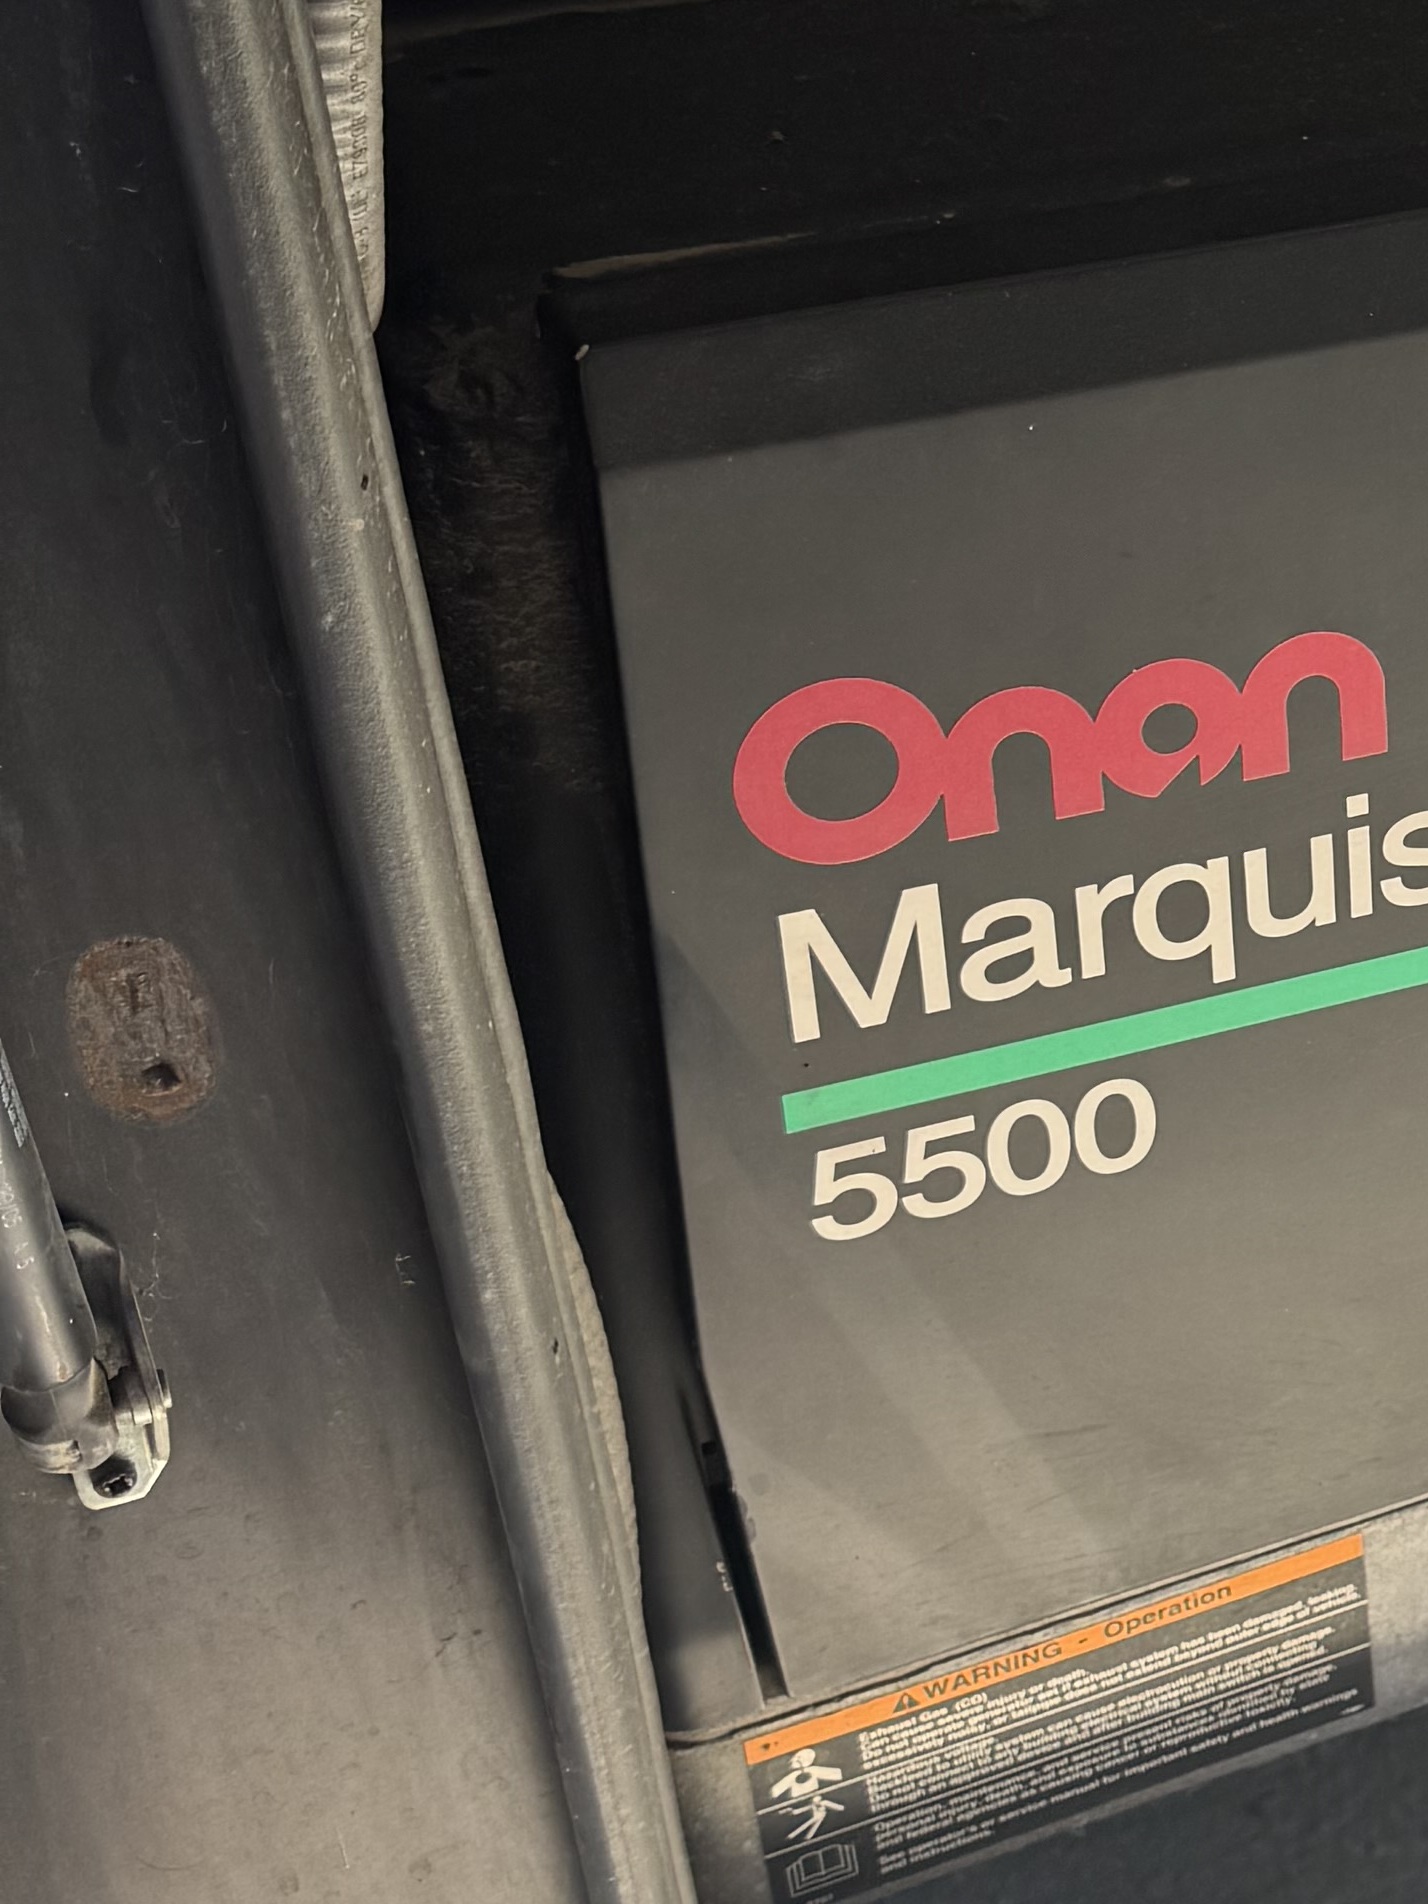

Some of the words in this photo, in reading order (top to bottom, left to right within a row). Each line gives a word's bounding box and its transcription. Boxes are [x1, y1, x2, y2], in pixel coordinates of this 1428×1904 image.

[732, 631, 1388, 866] Onan
[810, 1079, 1157, 1242] 5500
[923, 1640, 1063, 1698] WARNING
[1103, 1582, 1232, 1639] Operation
